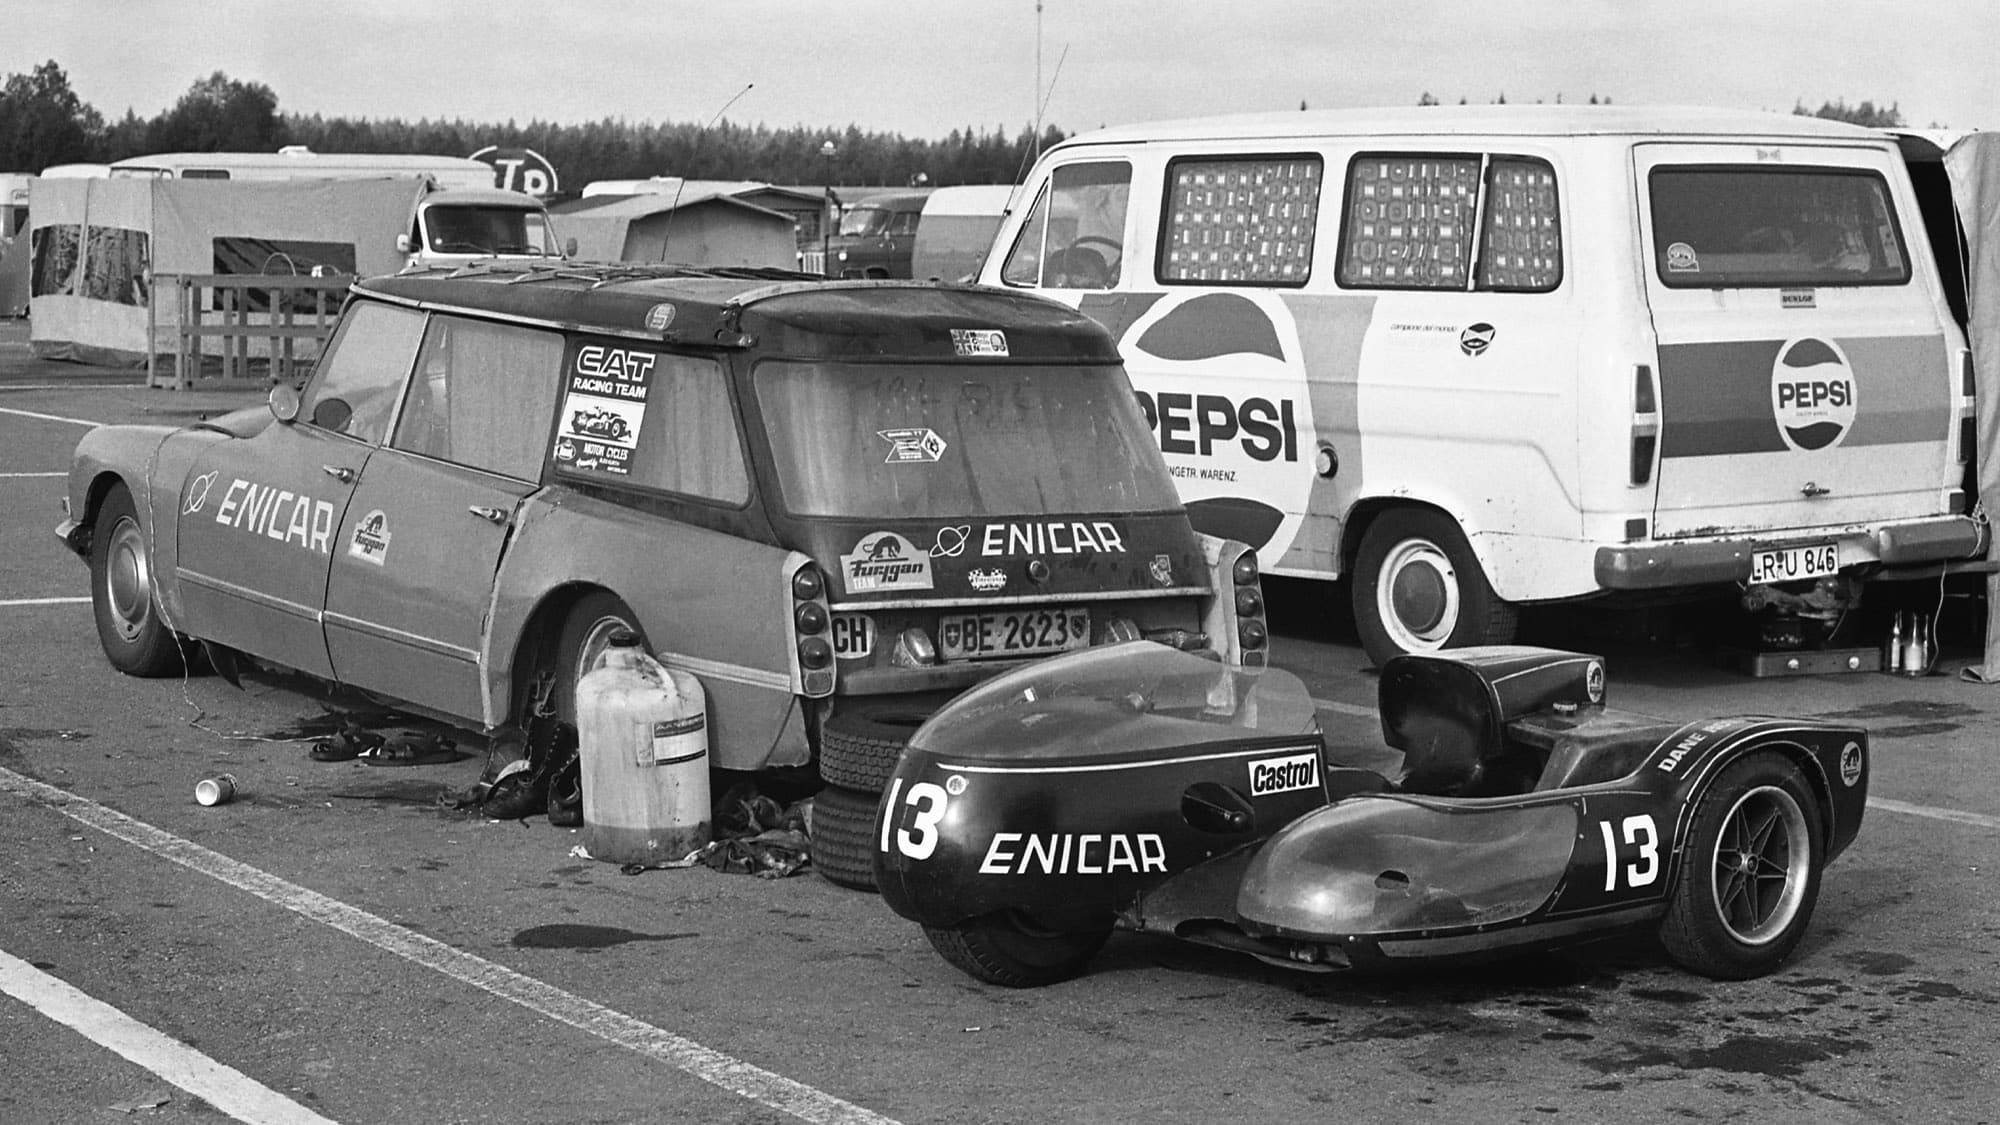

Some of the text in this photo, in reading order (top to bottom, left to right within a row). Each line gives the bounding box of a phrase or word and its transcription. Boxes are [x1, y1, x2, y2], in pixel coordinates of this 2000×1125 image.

[494, 159, 549, 195] TP
[577, 345, 656, 382] CAT
[573, 377, 647, 399] RACING TEAM
[1778, 380, 1852, 409] PEPSI
[1134, 390, 1298, 462] EPSI
[583, 442, 605, 457] MOTOR
[606, 447, 629, 461] CYCLES
[1166, 465, 1239, 482] NGETR. WARENZ.
[216, 478, 334, 554] ENICAR
[981, 522, 1127, 556] ENICAR
[1805, 546, 1836, 574] 846
[852, 576, 876, 590] TEAM
[831, 617, 867, 653] CH
[962, 613, 1069, 652] BE 2623
[1657, 732, 1707, 773] DANE
[1253, 758, 1315, 793] Castrol
[881, 778, 949, 860] 13
[978, 833, 1168, 874] ENICAR
[1599, 813, 1659, 892] 13
